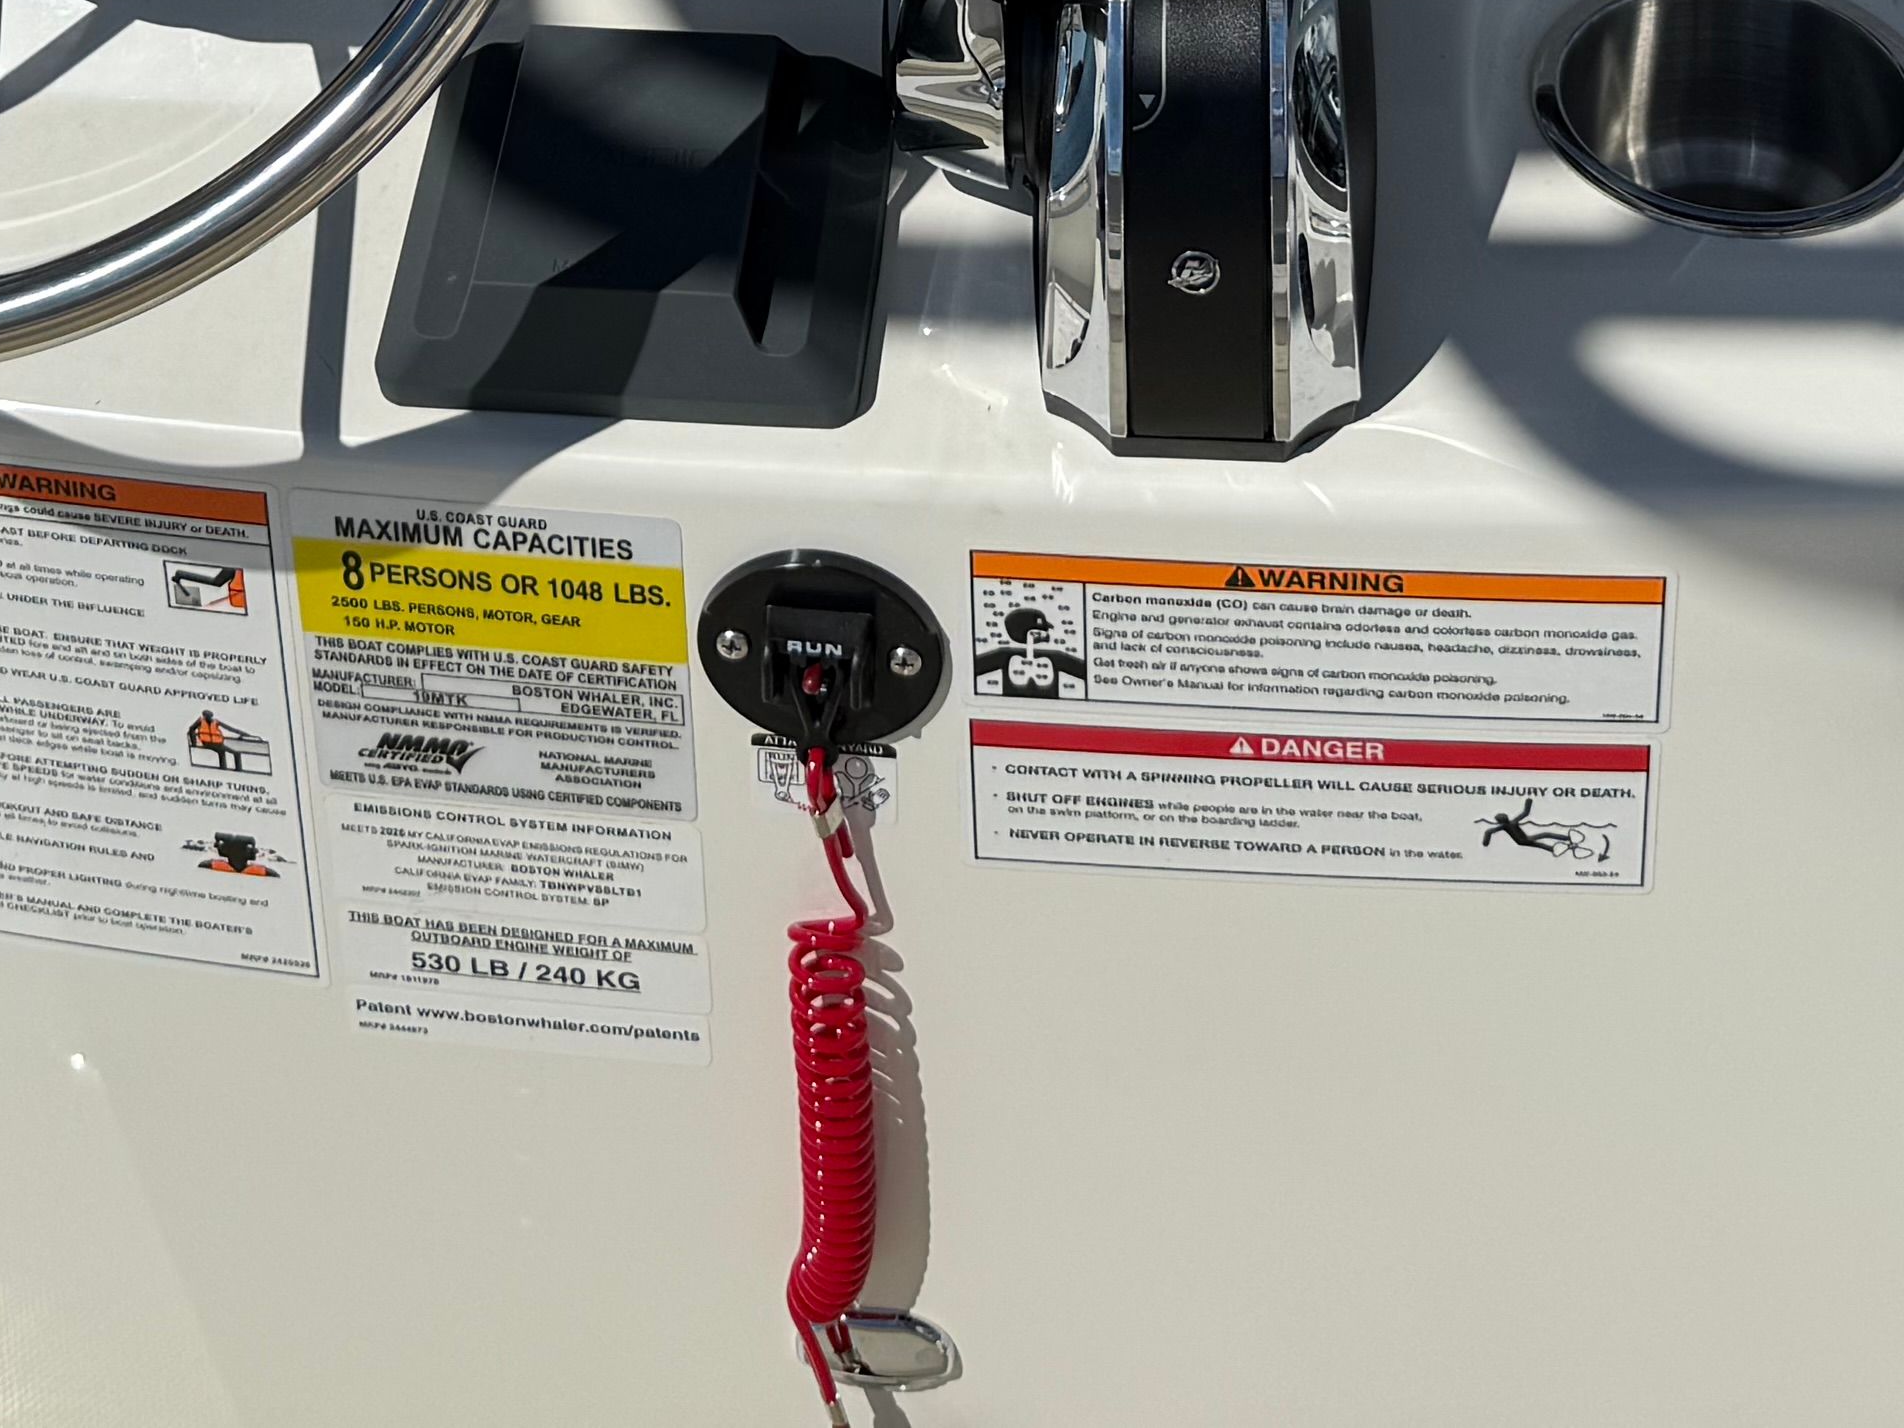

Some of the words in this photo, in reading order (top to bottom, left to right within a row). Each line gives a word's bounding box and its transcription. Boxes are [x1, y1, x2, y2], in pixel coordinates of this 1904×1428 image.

[24, 506, 55, 518] could
[57, 509, 91, 522] cause
[94, 512, 142, 527] SEVERE
[144, 518, 187, 532] INJURY
[190, 524, 202, 534] or
[415, 508, 442, 522] U.S.
[444, 510, 494, 527] COAST
[495, 514, 548, 532] GUARD
[333, 515, 464, 547] MAXIMUM
[471, 526, 634, 562] CAPACITIES
[339, 549, 366, 592] 8
[368, 561, 493, 593] PERSONS
[499, 572, 540, 597] OR
[546, 576, 604, 603] 1048
[613, 581, 671, 607] LBS.
[1255, 566, 1407, 594] WARNING
[330, 594, 369, 610] 2500
[372, 598, 405, 613] LBS.
[407, 601, 479, 620] PERSONS,
[481, 607, 537, 625] MOTOR,
[539, 612, 581, 628] GEAR
[374, 617, 401, 631] H.P.
[403, 619, 456, 636] MOTOR
[346, 637, 384, 653] BOAT
[385, 641, 454, 659] COMPLIES
[455, 647, 490, 662] WITH
[492, 650, 519, 665] U.S.
[520, 653, 568, 669] COAST
[569, 657, 619, 674] GUARD
[620, 661, 674, 678] SAFETY
[786, 639, 843, 657] RUN
[310, 667, 417, 689] MANUFACTURER:
[312, 647, 393, 667] STANDARDS
[395, 656, 410, 668] IN
[411, 657, 463, 673] EFFECT
[465, 662, 486, 676] ON
[487, 664, 515, 678] THE
[517, 666, 553, 681] DATE
[554, 670, 575, 683] OF
[576, 671, 677, 692] CERTIFICATION
[312, 680, 360, 696] MODEL:
[511, 683, 574, 701] BOSTON
[576, 688, 645, 708] WHALER,
[648, 695, 678, 709] INC.
[559, 700, 657, 721] EDGEWATER,
[660, 709, 679, 722] FL
[1260, 737, 1385, 761] DANGER
[1003, 763, 1079, 779] CONTACT
[1081, 767, 1122, 781] WITH
[1125, 770, 1137, 781] A
[1140, 771, 1216, 785] SPINNING
[1219, 774, 1314, 791] PROPELLER
[1316, 779, 1356, 791] WILL
[1357, 780, 1413, 793] CAUSE
[1415, 782, 1487, 796] SERIOUS
[1490, 784, 1549, 800] INJURY
[1551, 786, 1577, 798] OR
[1579, 786, 1636, 800] DEATH.
[352, 801, 432, 820] EMISSIONS
[435, 810, 506, 826] CONTROL
[508, 817, 568, 833] SYSTEM
[570, 822, 672, 841] INFORMATION
[410, 951, 461, 974] 530
[470, 956, 510, 979] LB
[516, 960, 529, 981] /
[534, 963, 586, 985] 240
[595, 968, 640, 990] KG
[355, 998, 412, 1016] Patent
